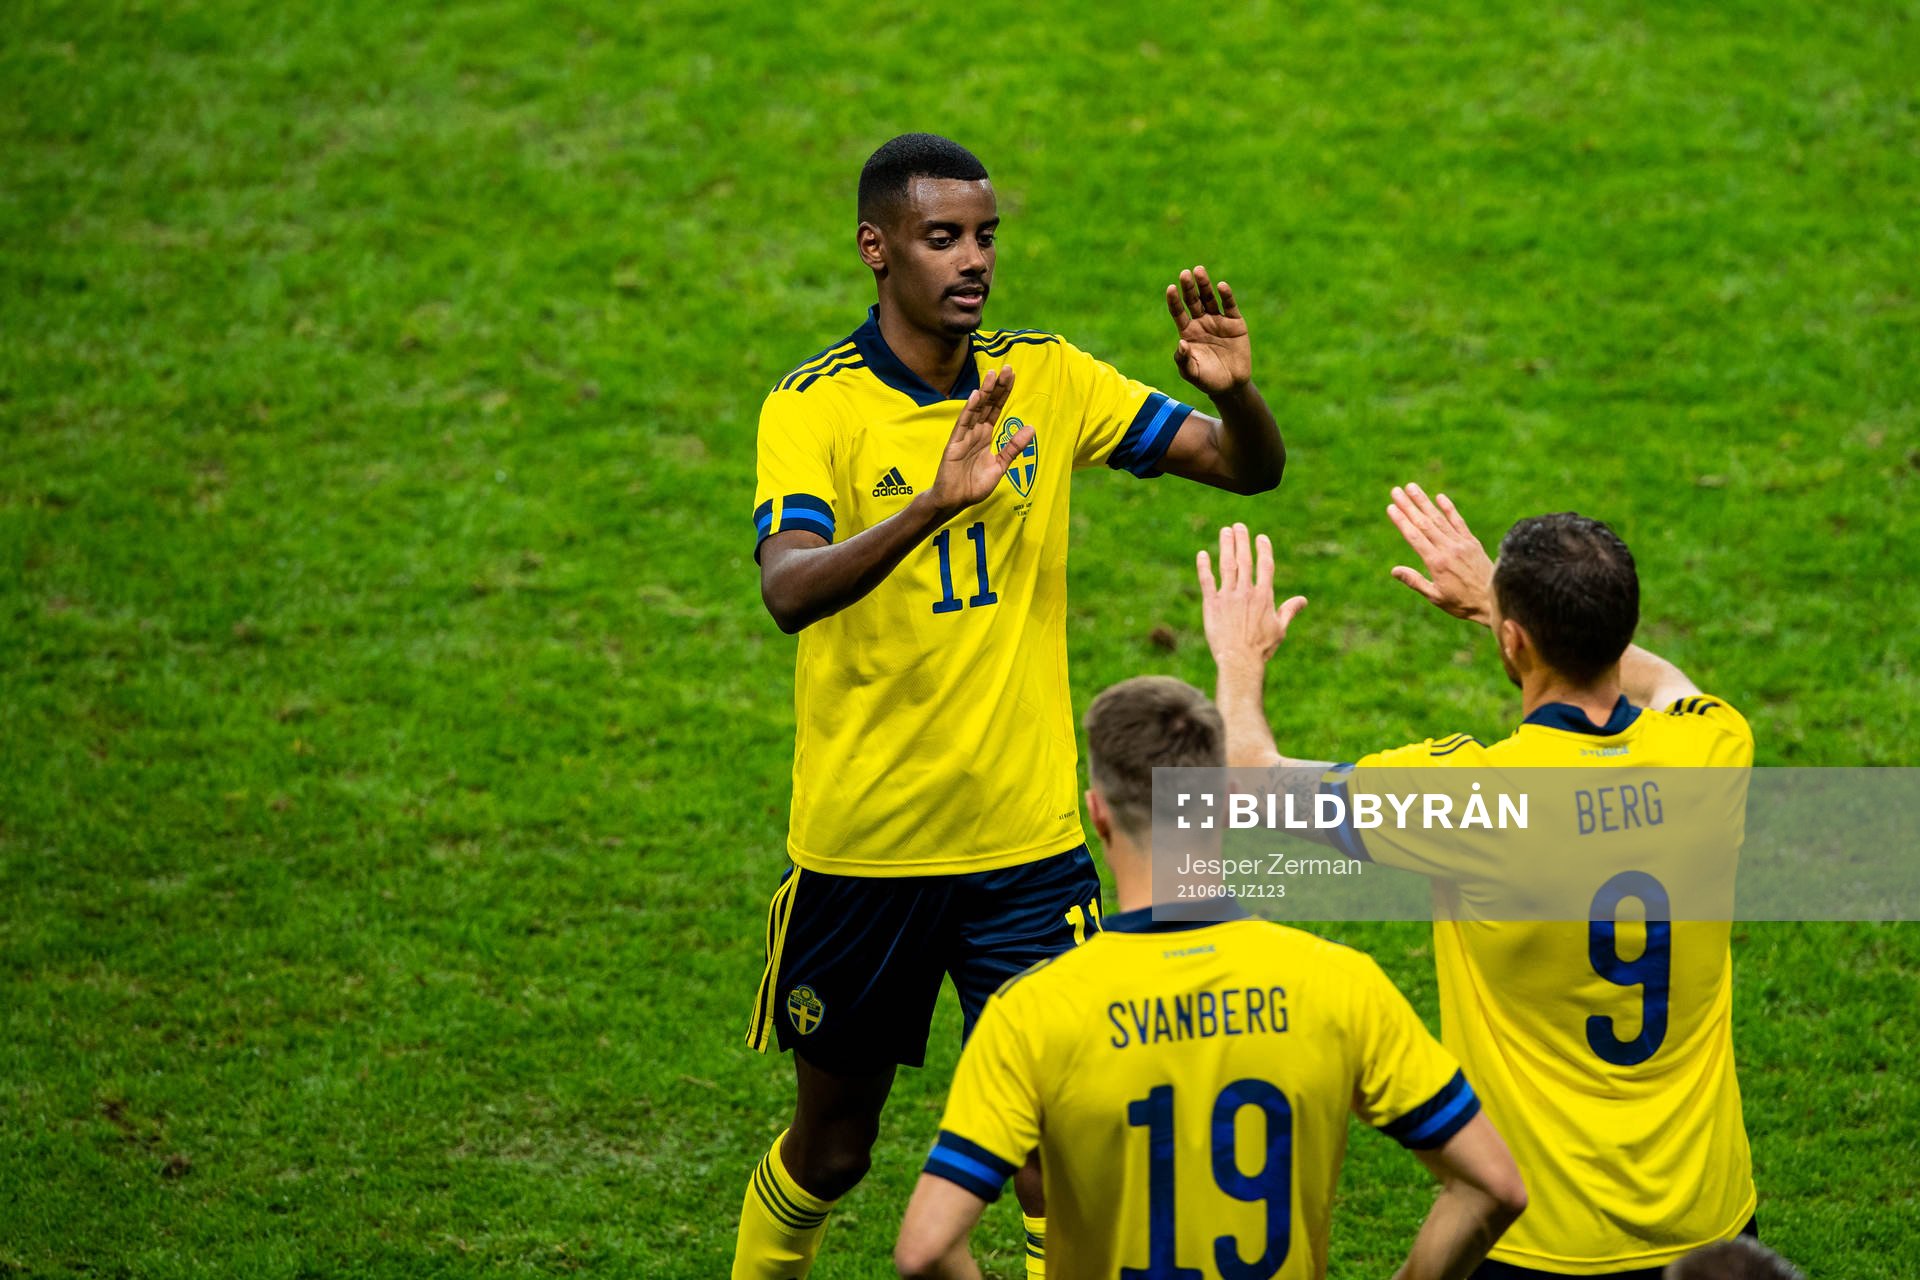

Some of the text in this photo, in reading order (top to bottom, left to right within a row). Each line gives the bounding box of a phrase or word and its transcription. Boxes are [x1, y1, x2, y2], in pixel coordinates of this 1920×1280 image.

[872, 485, 914, 497] adidas
[932, 522, 998, 614] 11
[1575, 781, 1664, 835] BERG
[1586, 870, 1671, 1066] 9
[1108, 987, 1289, 1048] SVANBERG
[1120, 1078, 1293, 1280] 19
